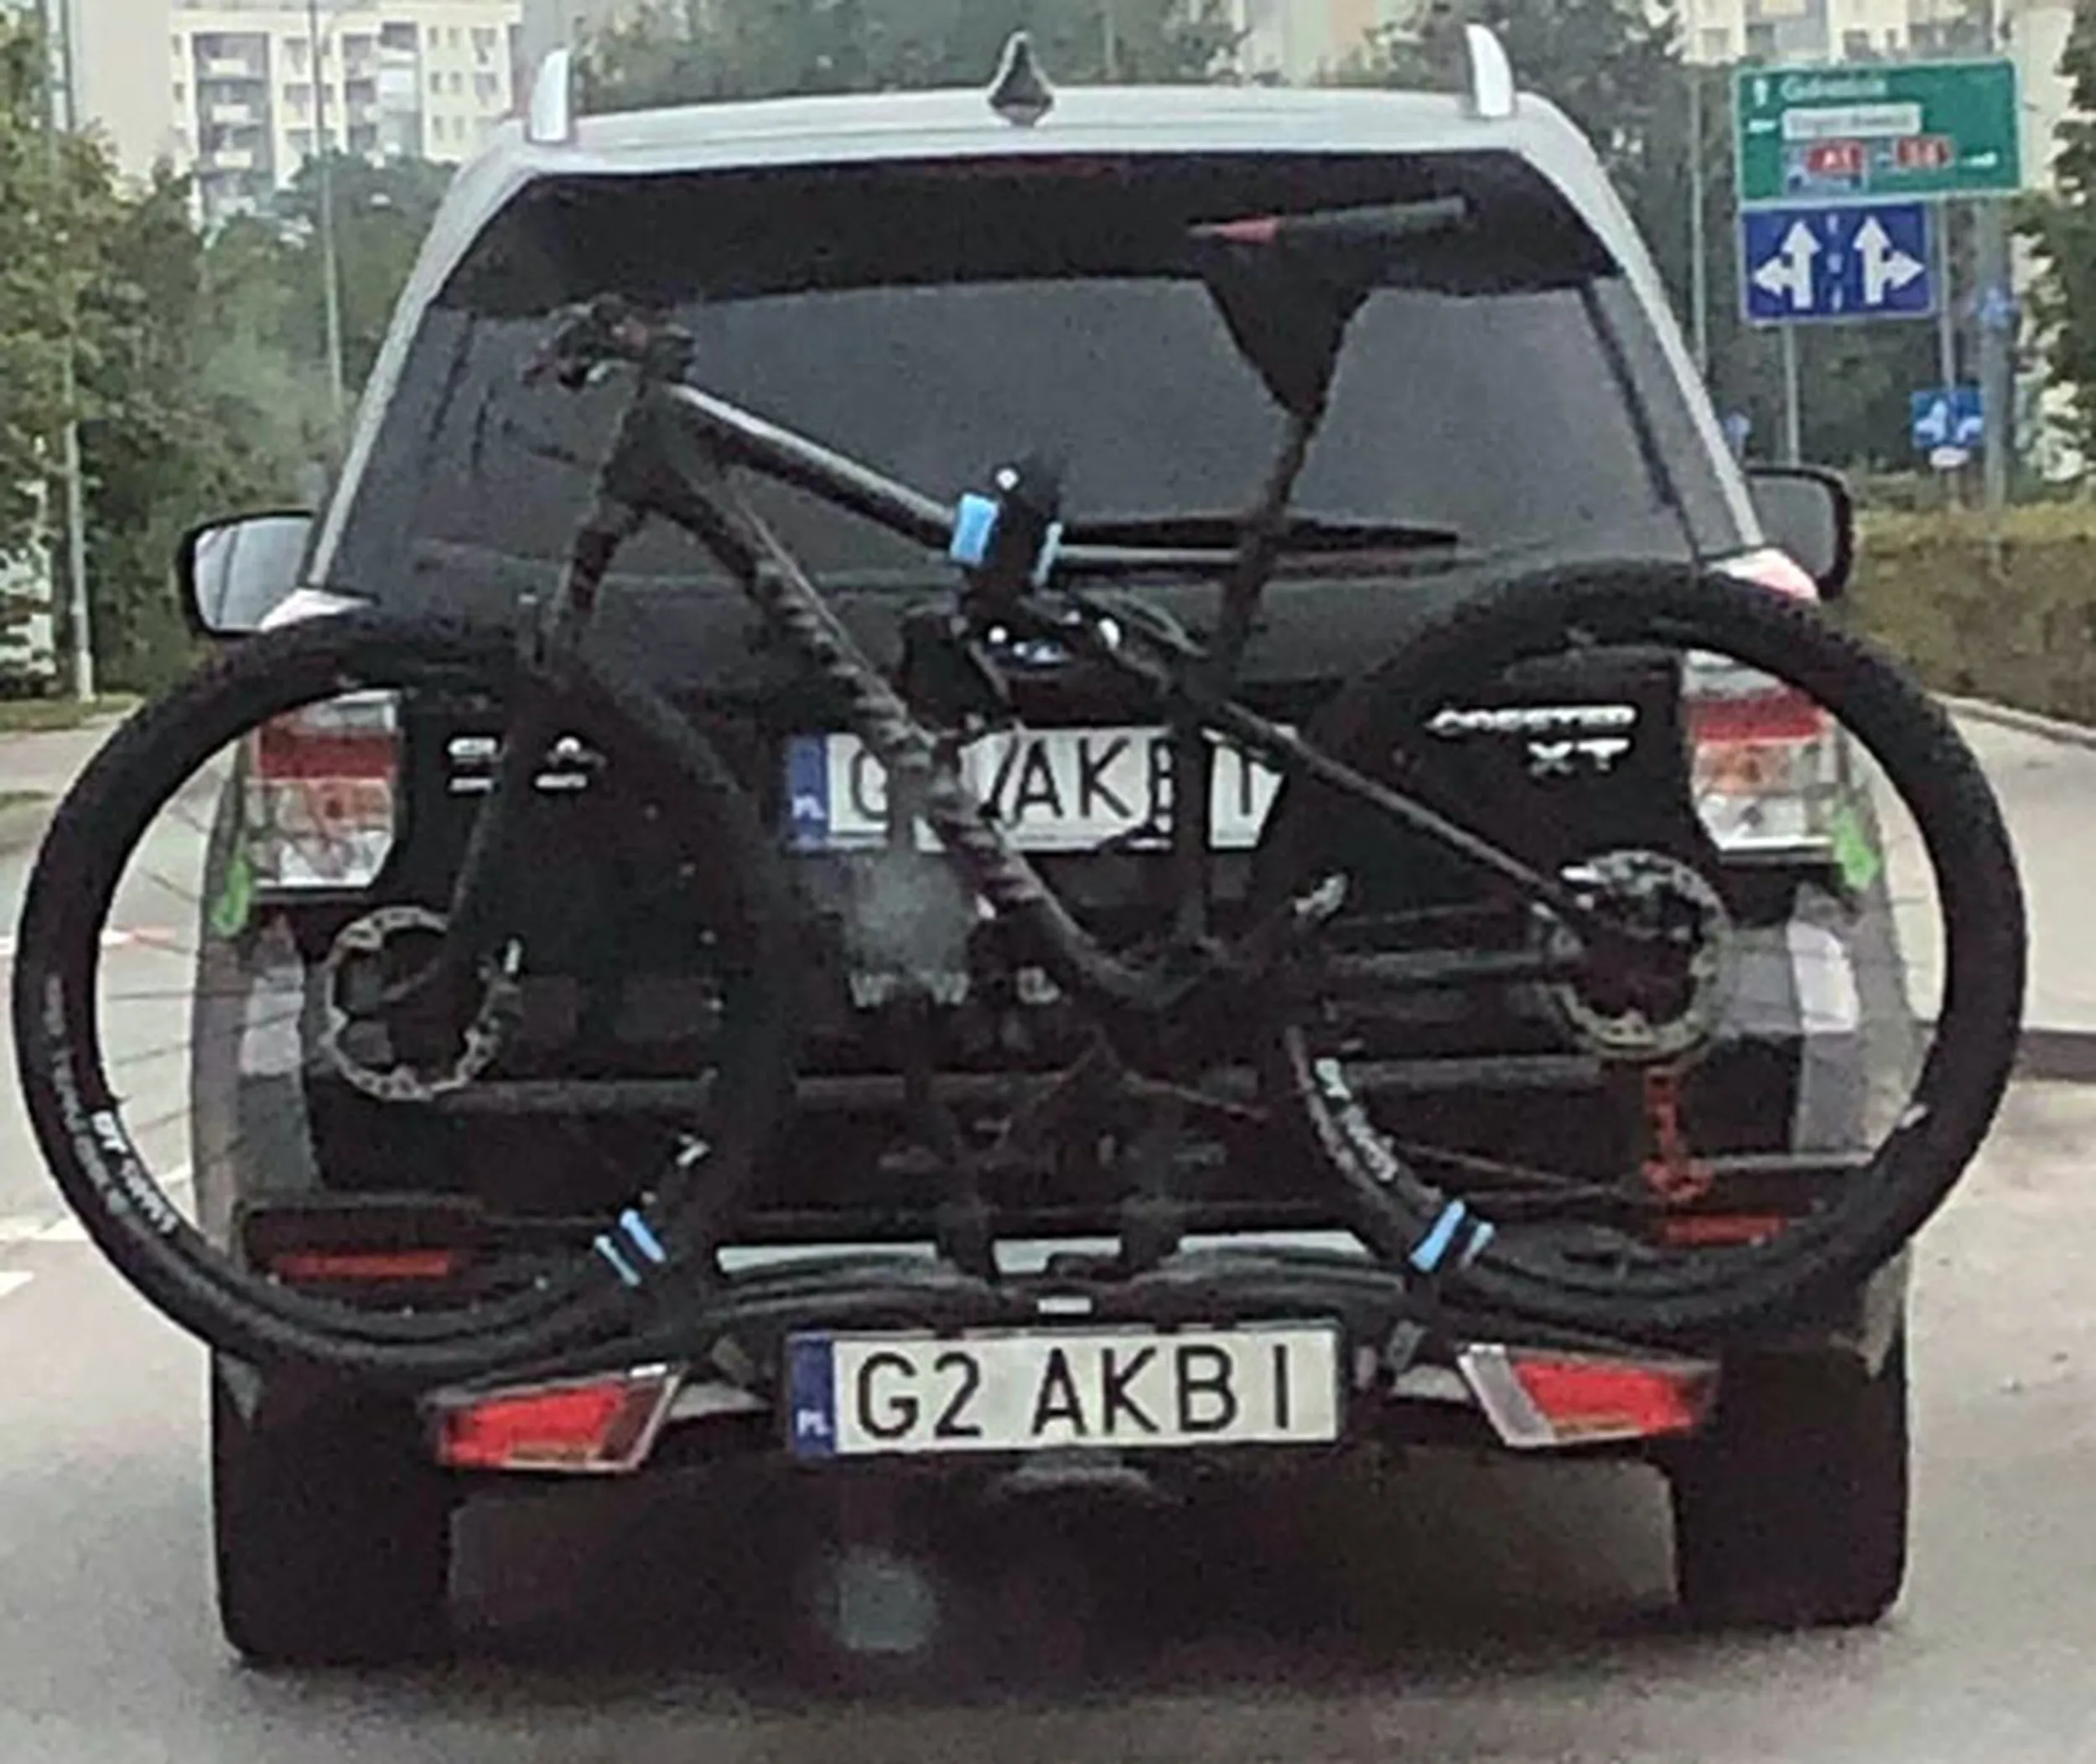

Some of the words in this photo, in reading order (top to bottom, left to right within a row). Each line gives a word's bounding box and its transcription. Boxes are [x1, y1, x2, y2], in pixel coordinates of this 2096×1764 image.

[1528, 738, 1629, 775] XT
[858, 1351, 982, 1440] G2
[1032, 1344, 1289, 1437] AKBI
[797, 1409, 830, 1437] PL
